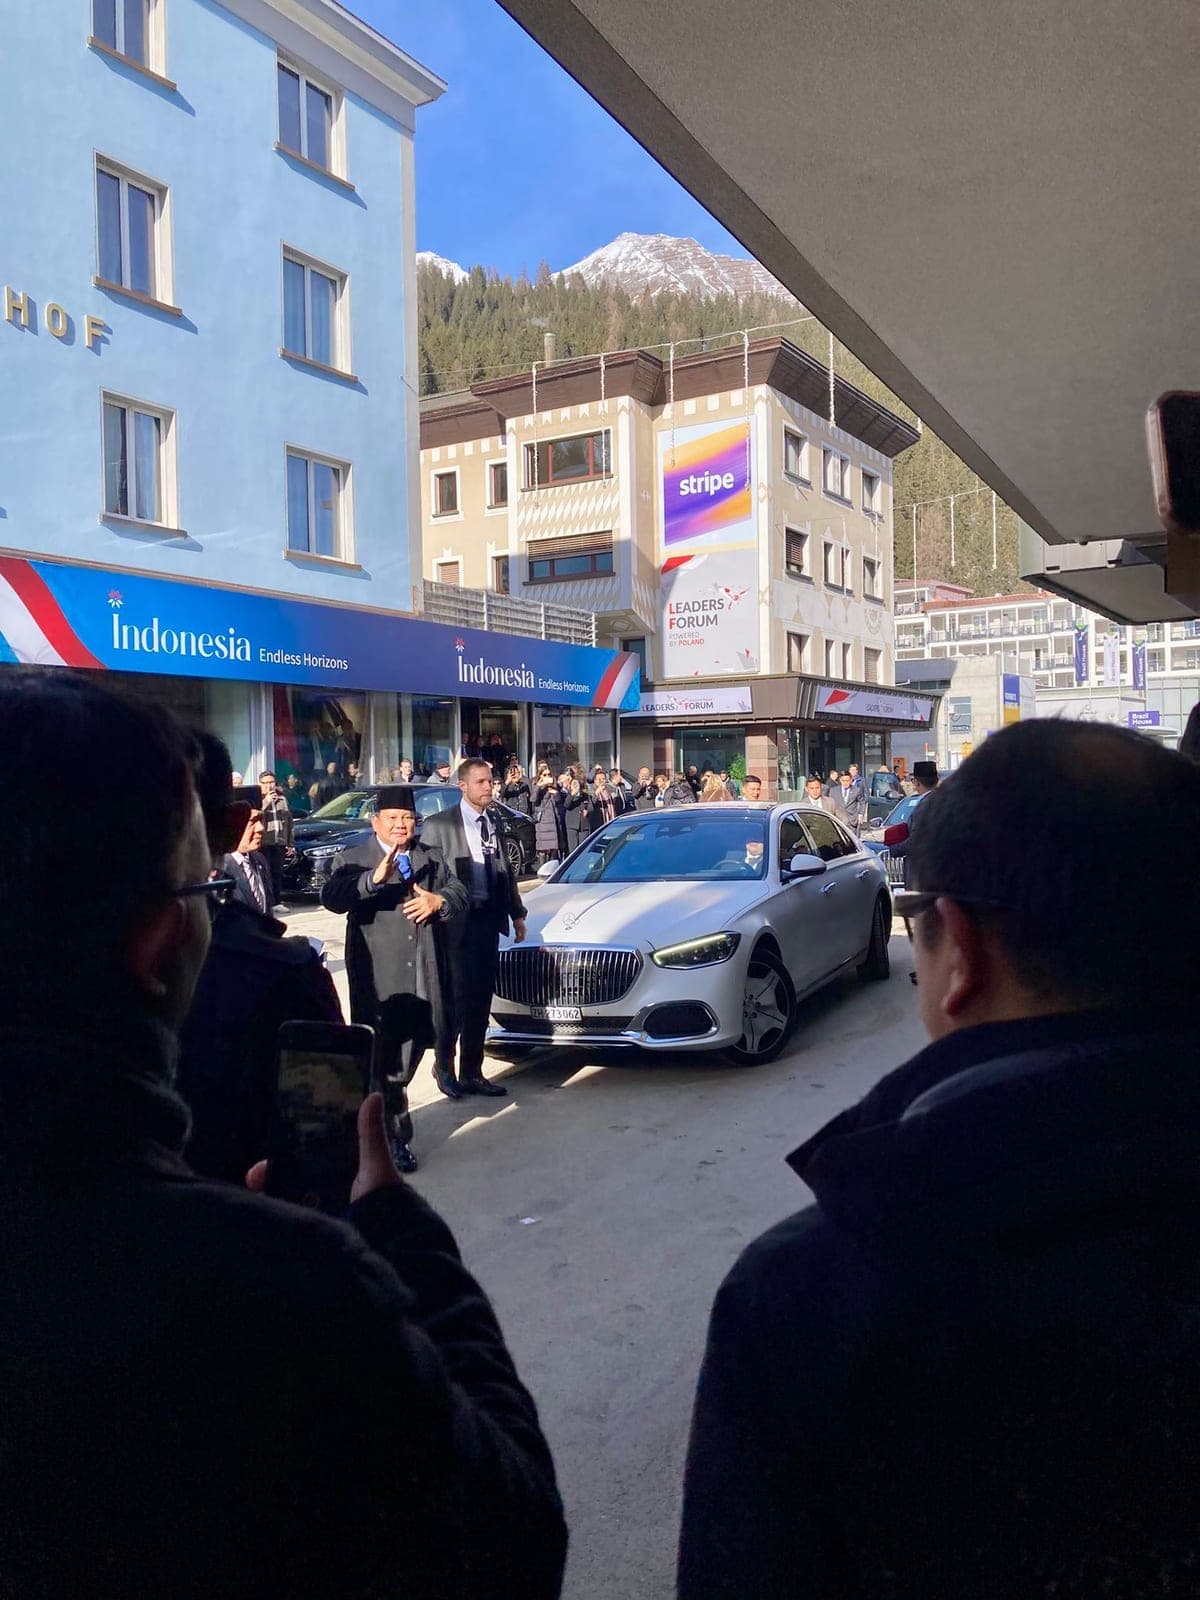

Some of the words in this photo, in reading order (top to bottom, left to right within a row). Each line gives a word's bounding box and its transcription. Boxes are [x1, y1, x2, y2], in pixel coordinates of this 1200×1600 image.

[679, 471, 734, 496] stripe
[669, 598, 724, 615] LEADERS
[669, 614, 719, 630] FORUM
[112, 613, 251, 661] Indonesia
[259, 648, 301, 665] Endless
[303, 653, 349, 670] Horizons
[669, 631, 700, 640] POWERED
[678, 638, 705, 647] POLAND
[458, 655, 535, 688] Indonesia
[538, 678, 563, 690] Endless
[563, 681, 590, 694] Horizons
[642, 703, 675, 712] LEADERS
[685, 701, 714, 711] FORUM
